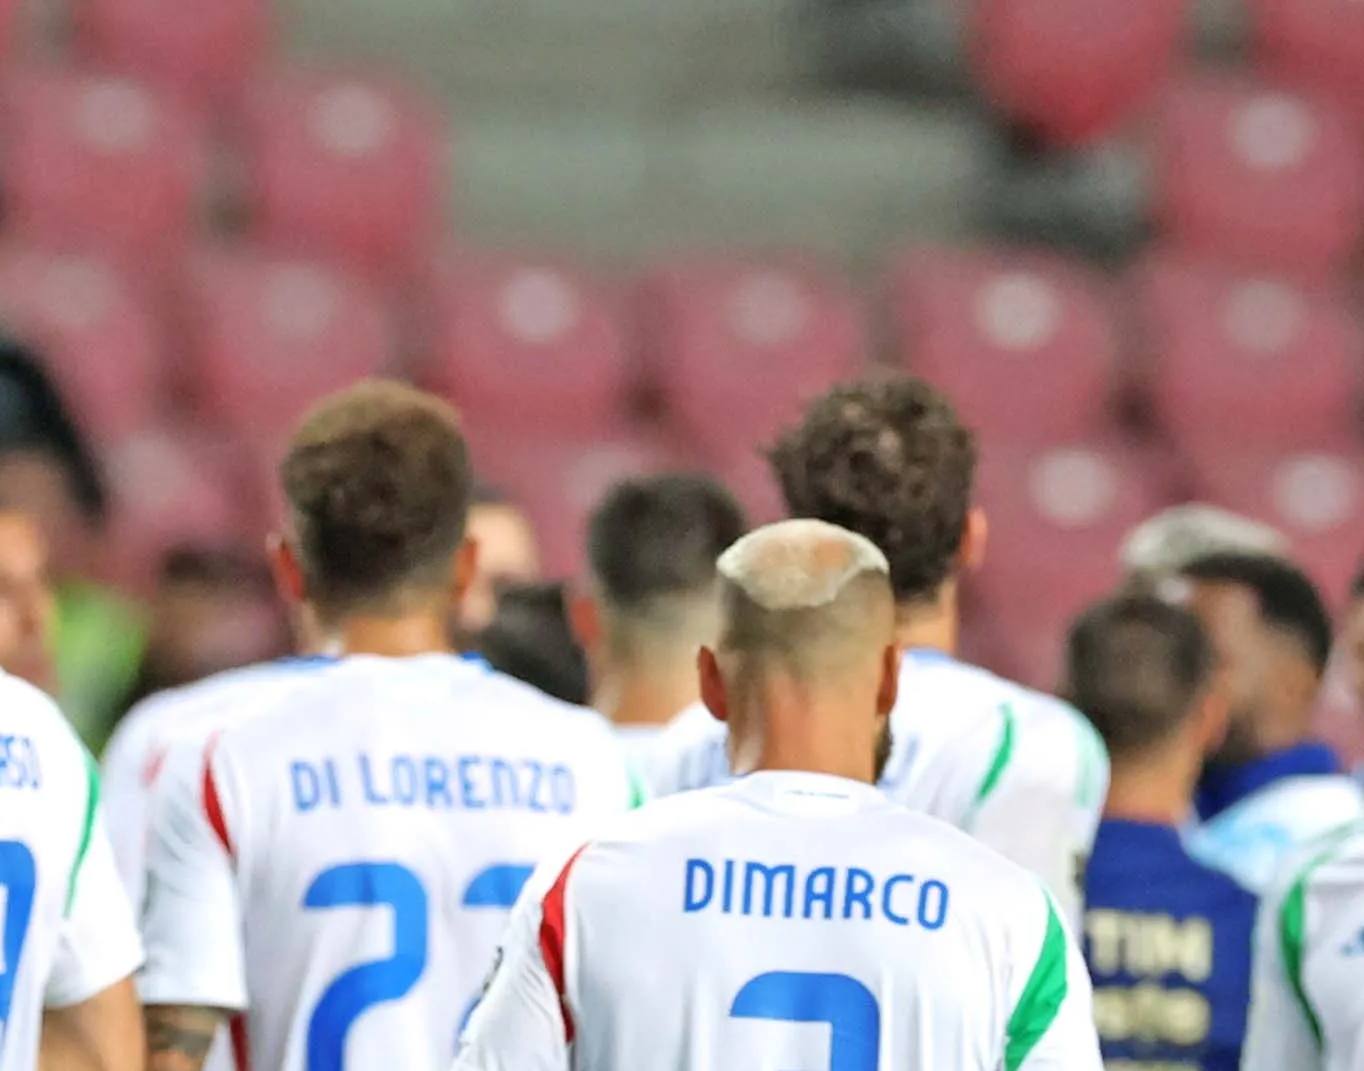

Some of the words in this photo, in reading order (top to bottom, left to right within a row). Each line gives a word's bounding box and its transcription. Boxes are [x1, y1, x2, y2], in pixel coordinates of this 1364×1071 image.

[287, 757, 344, 814] DI
[355, 750, 578, 816] LORENZO
[682, 857, 950, 931] DIMARCO
